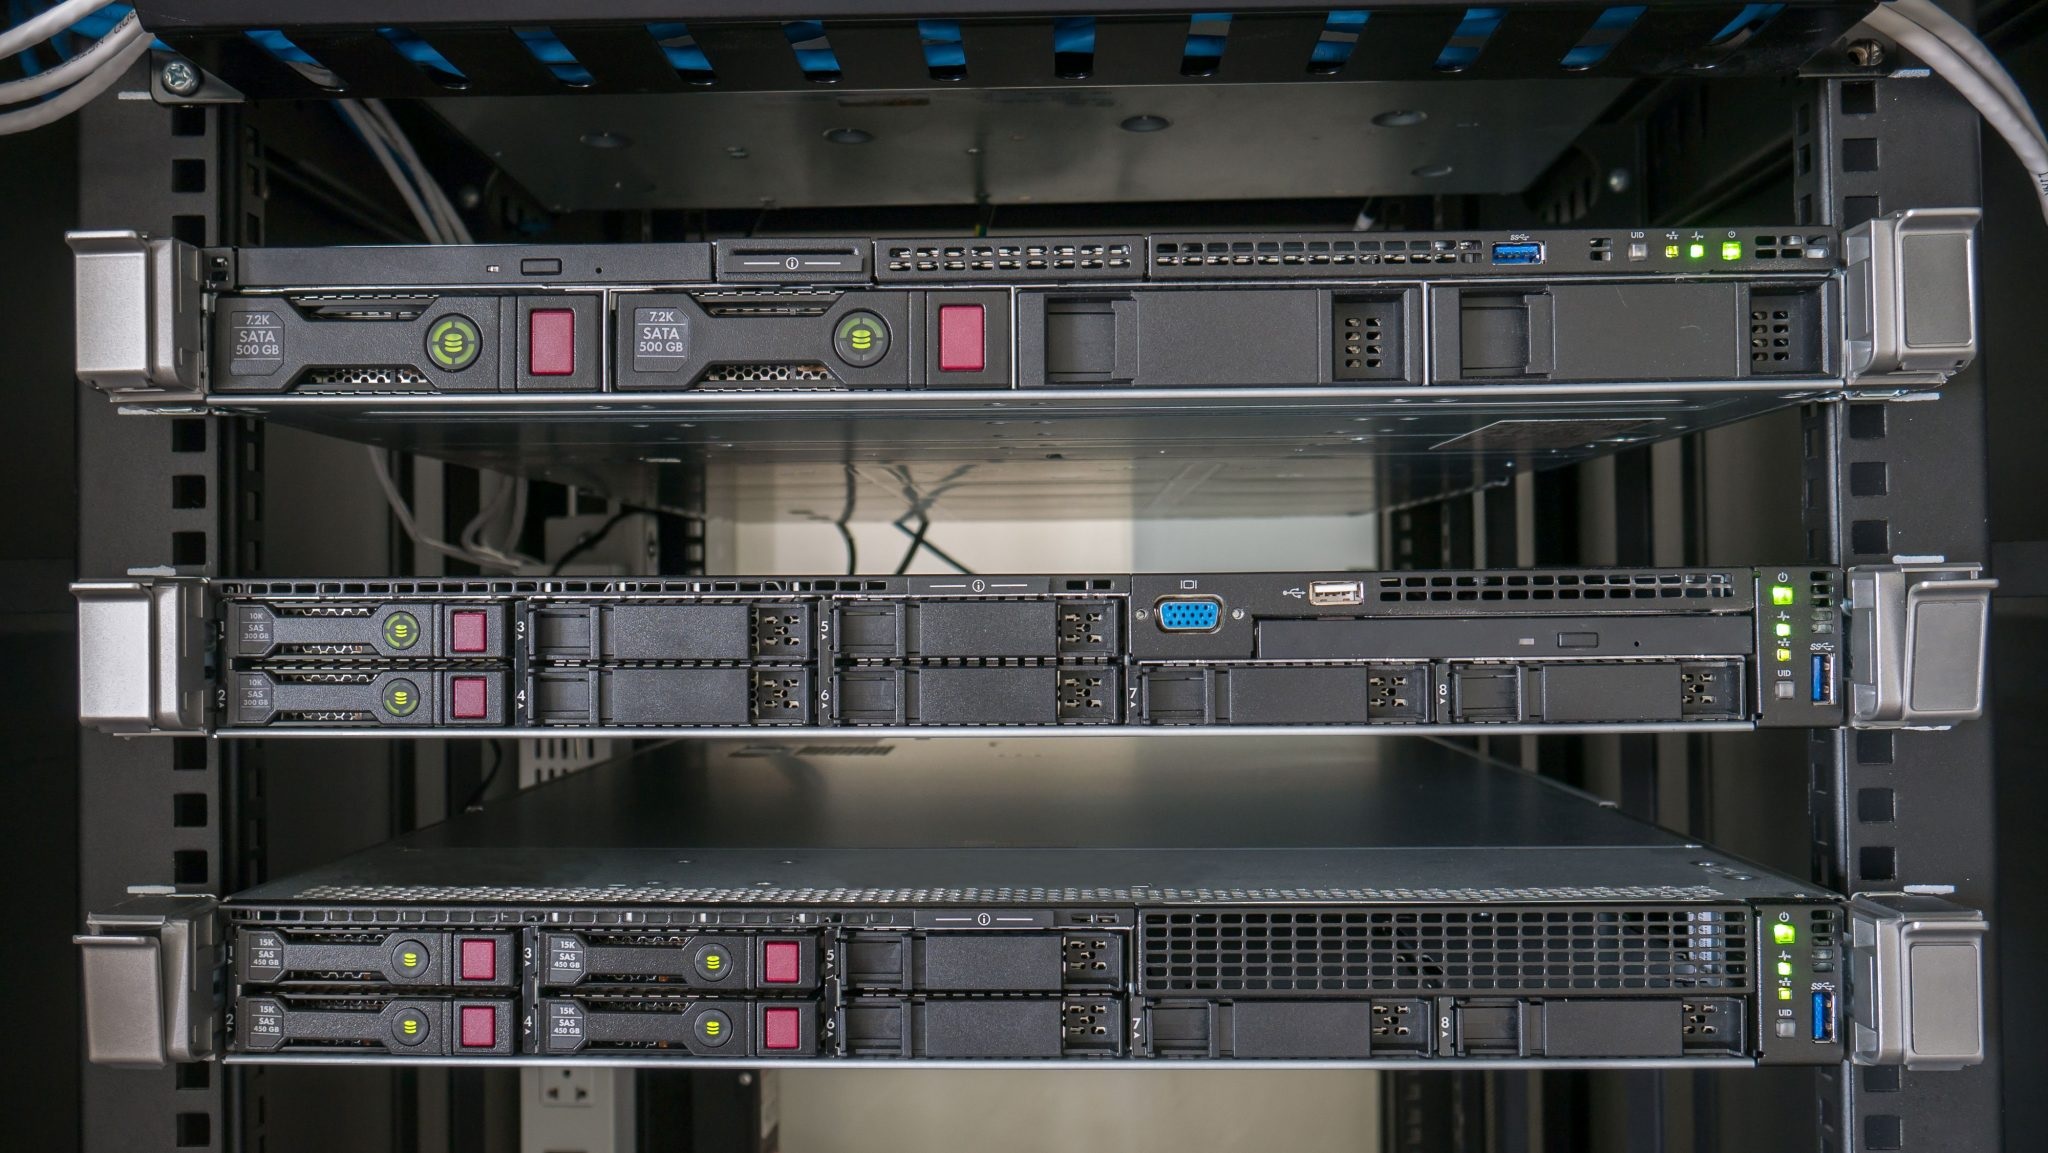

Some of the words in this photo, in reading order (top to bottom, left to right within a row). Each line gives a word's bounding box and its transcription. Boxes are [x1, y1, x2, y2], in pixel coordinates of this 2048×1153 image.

[1630, 231, 1645, 239] UID
[246, 314, 270, 326] 7.2K
[649, 311, 674, 322] 7.2K
[239, 330, 276, 343] SATA
[643, 327, 680, 340] SATA
[236, 344, 259, 355] 500
[262, 344, 279, 355] GB
[639, 341, 663, 352] 500
[665, 341, 683, 352] GB
[249, 612, 263, 620] 10K
[248, 624, 264, 632] SAS
[517, 621, 525, 632] 3
[820, 621, 829, 632] 5
[1777, 669, 1791, 677] UID
[218, 689, 226, 701] 2
[247, 690, 264, 698] SAS
[516, 690, 526, 701] 4
[820, 690, 829, 701] 6
[1129, 687, 1137, 699] 7
[1439, 684, 1447, 696] 8
[259, 938, 274, 946] 15K
[560, 941, 576, 949] 15K
[228, 946, 233, 957] 1
[258, 950, 275, 958] SAS
[524, 947, 532, 959] 3
[559, 952, 576, 960] SAS
[826, 949, 835, 961] 5
[253, 958, 267, 966] 450
[260, 1005, 274, 1013] 15K
[560, 1007, 575, 1015] 15K
[1778, 1009, 1792, 1017] UID
[226, 1013, 234, 1025] 2
[258, 1017, 275, 1026] SAS
[523, 1016, 532, 1027] 4
[558, 1018, 575, 1027] SAS
[826, 1018, 835, 1029] 6
[1132, 1017, 1141, 1029] 7
[1441, 1016, 1450, 1028] 8
[253, 1025, 267, 1033] 450
[268, 1025, 280, 1033] GB
